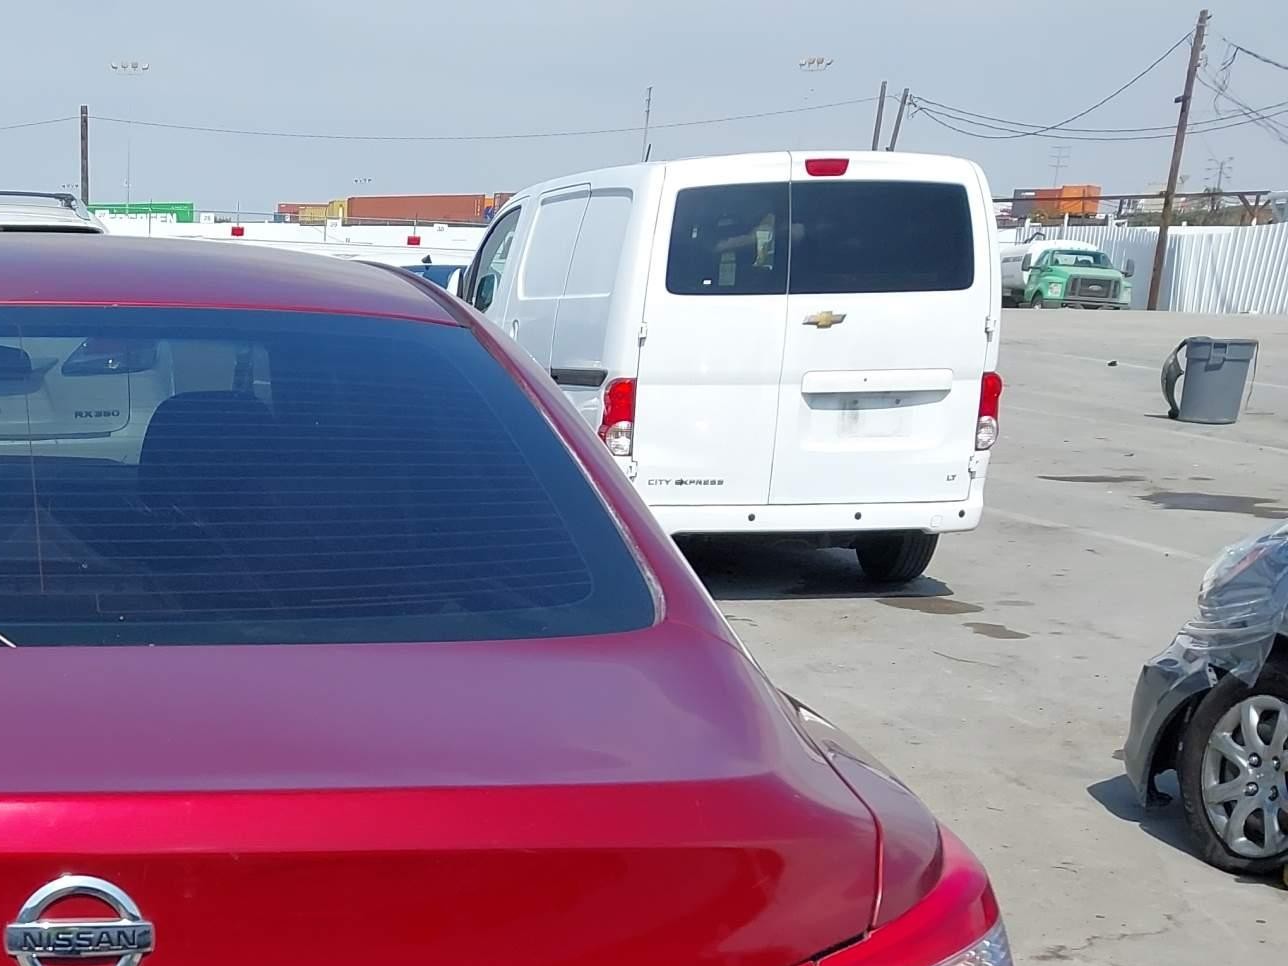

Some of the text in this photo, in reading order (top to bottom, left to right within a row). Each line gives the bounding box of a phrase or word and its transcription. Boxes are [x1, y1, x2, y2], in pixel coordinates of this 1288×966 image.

[674, 478, 724, 486] EXPRESS
[946, 474, 957, 482] LT
[22, 929, 138, 950] NISSAN
